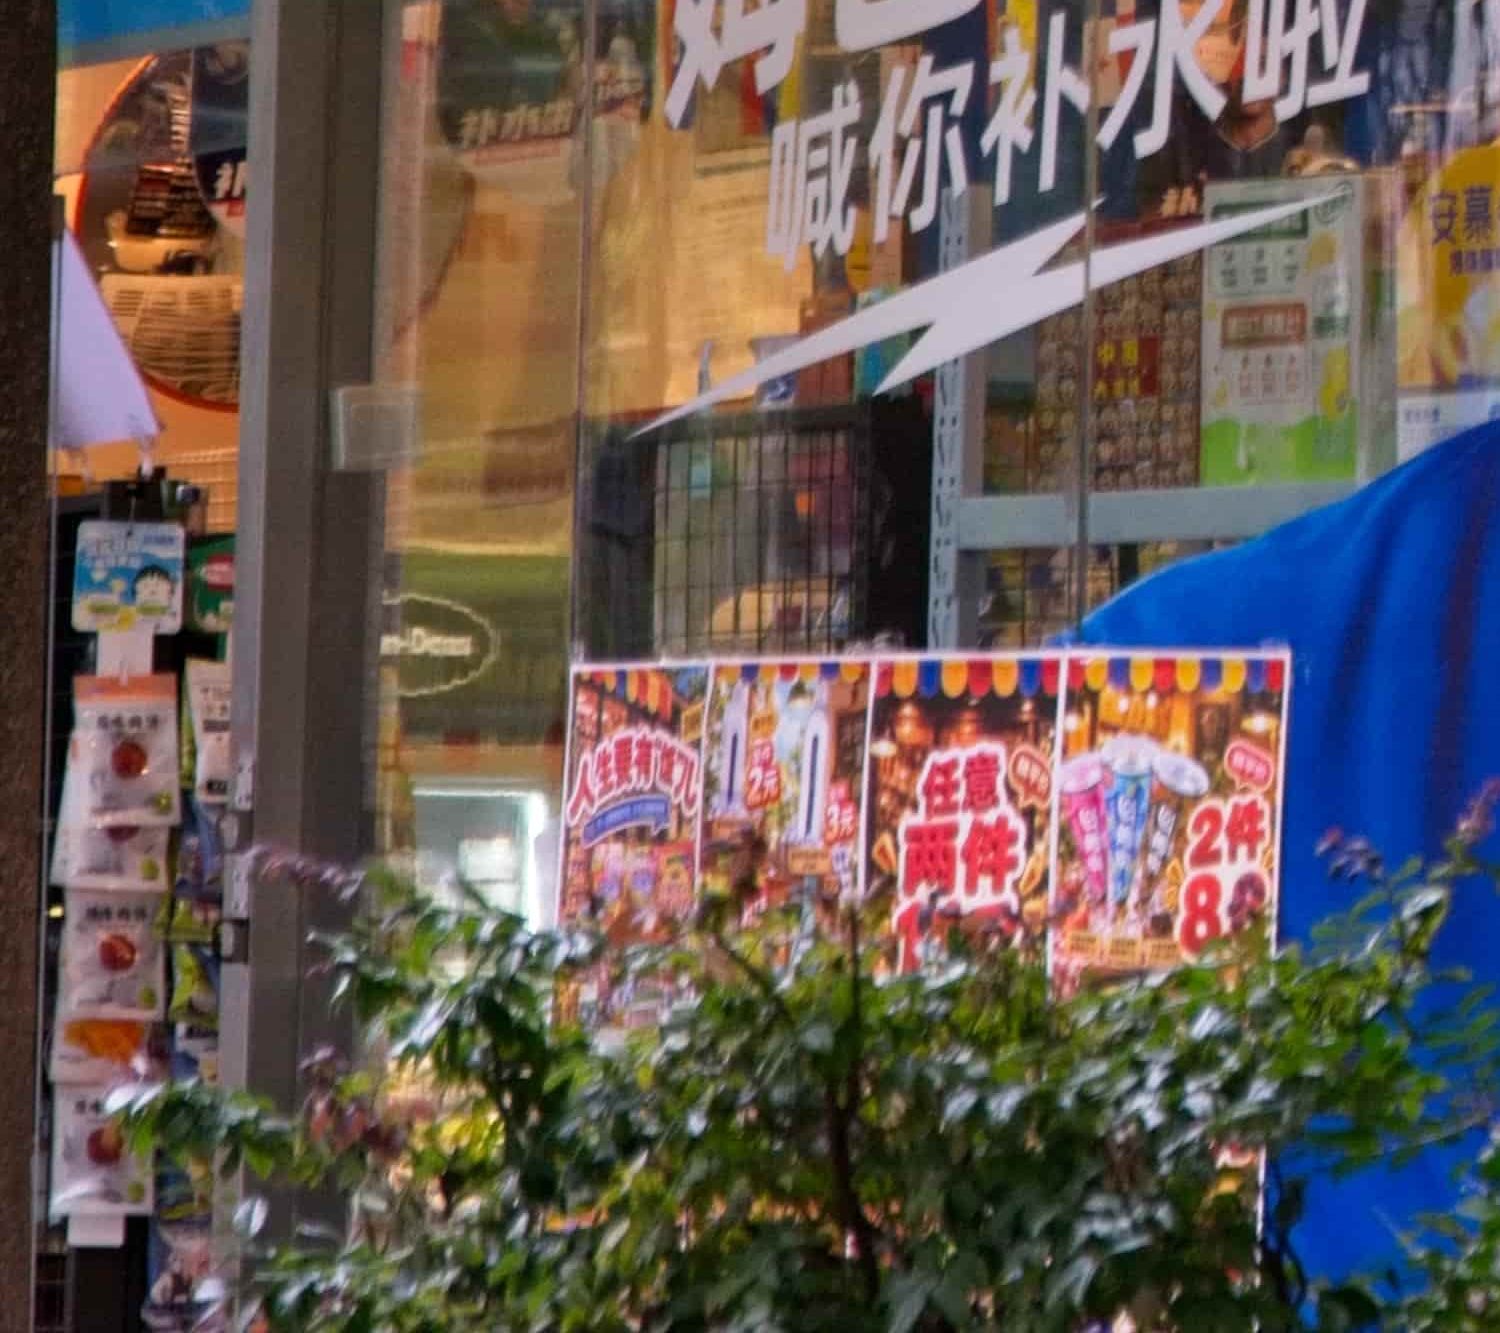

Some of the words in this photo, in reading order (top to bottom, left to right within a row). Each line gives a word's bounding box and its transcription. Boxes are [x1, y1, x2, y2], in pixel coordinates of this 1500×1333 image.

[923, 752, 1000, 816] 任意
[902, 815, 1020, 898] 两件
[1189, 799, 1266, 871] 2件
